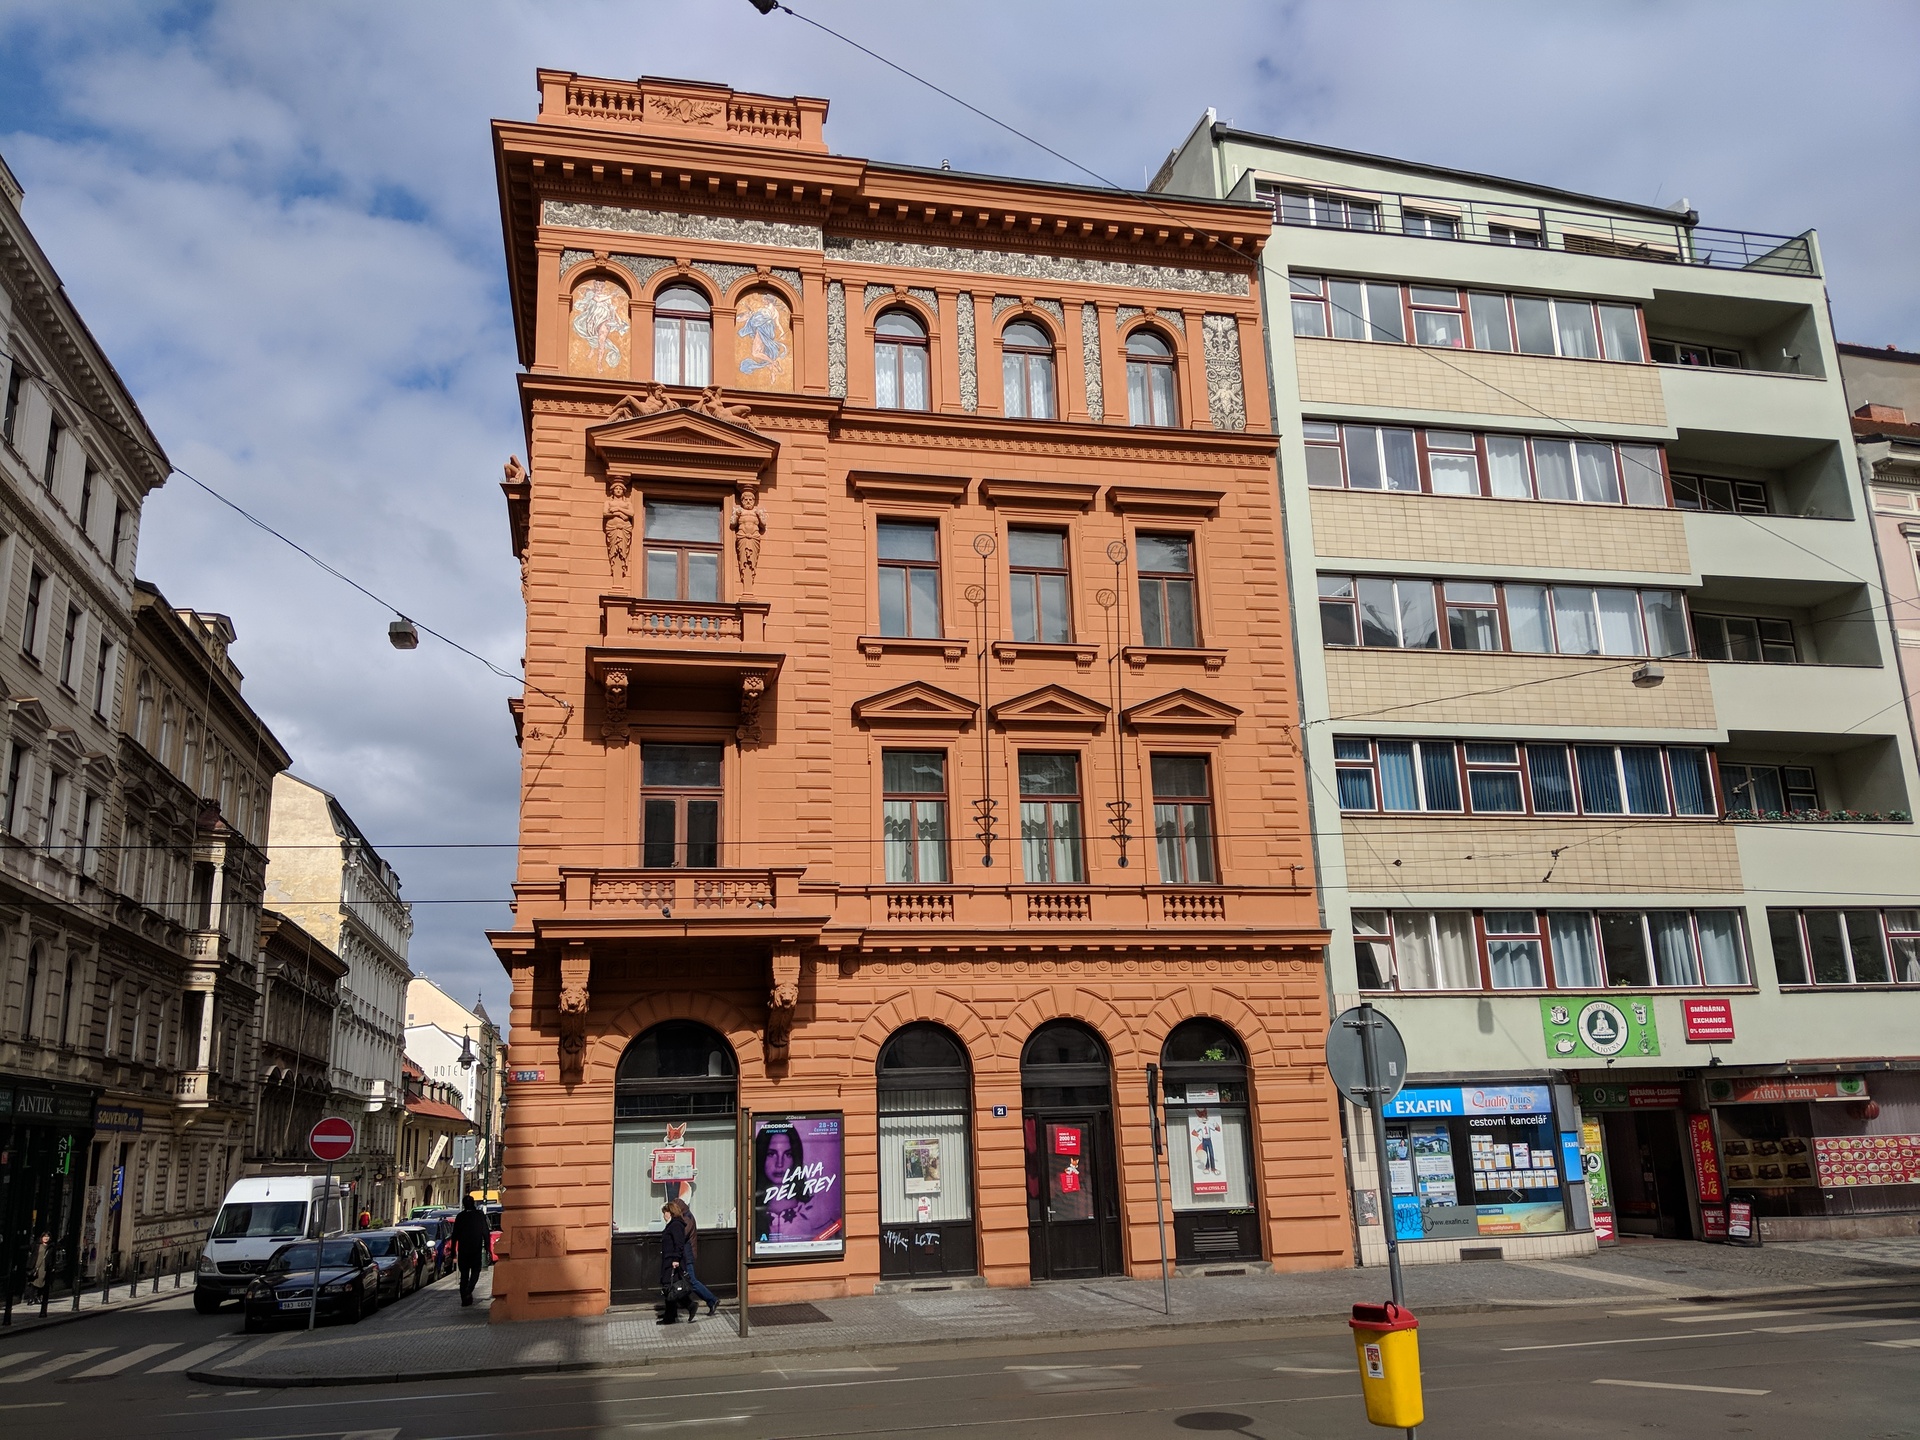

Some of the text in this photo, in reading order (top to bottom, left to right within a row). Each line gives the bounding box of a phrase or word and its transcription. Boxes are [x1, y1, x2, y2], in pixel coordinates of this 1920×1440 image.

[1586, 1003, 1616, 1013] BUDDHA
[1690, 1004, 1726, 1013] SMĚNÁRNA
[1591, 1042, 1621, 1053] ČAJOVNA
[434, 1065, 464, 1077] HOTEL
[1788, 1088, 1819, 1099] PERLA
[18, 1095, 54, 1114] ANTIK
[1395, 1099, 1452, 1114] EXAFIN
[97, 1110, 128, 1124] SOUVENIR
[997, 1107, 1004, 1115] 21
[1469, 1114, 1548, 1127] cestovní kancelář
[56, 1137, 68, 1175] ANTIK
[782, 1161, 824, 1184] LANA
[763, 1173, 837, 1204] DEL REY
[1431, 1217, 1470, 1226] www.exafin.cz
